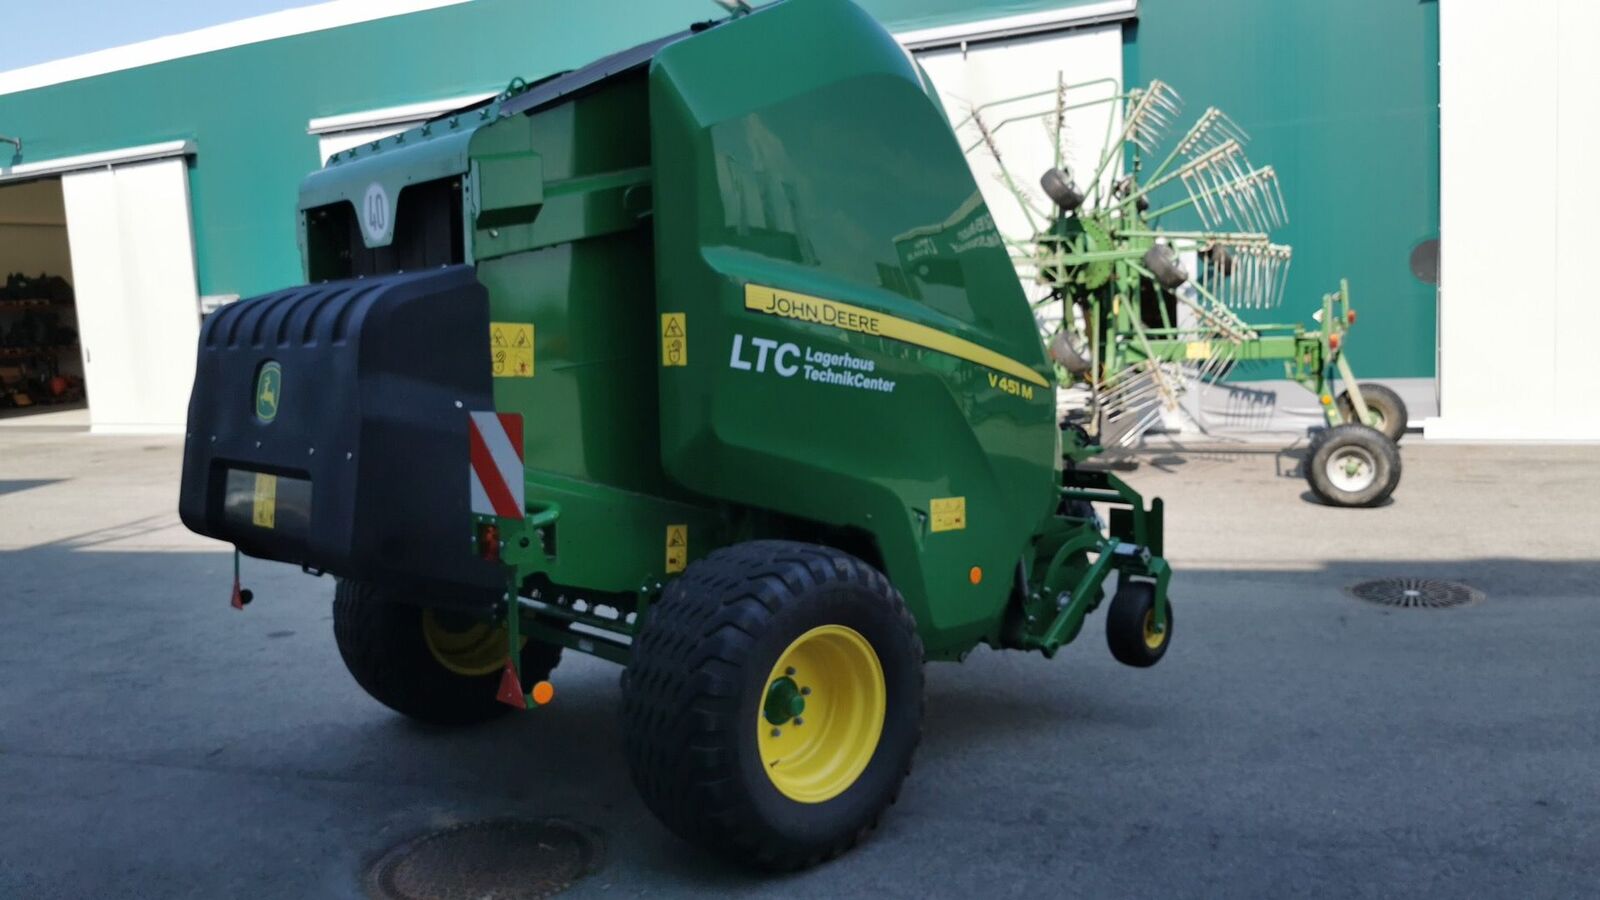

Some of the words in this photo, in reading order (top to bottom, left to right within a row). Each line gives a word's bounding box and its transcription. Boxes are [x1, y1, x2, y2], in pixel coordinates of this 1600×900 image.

[368, 193, 385, 231] 40
[766, 293, 818, 319] JOHN
[823, 304, 880, 332] DEERE
[730, 334, 801, 377] LTC
[805, 347, 875, 371] Lagerhaus
[804, 365, 896, 392] TechnikCenter
[988, 372, 998, 388] V
[998, 377, 1020, 396] 451
[1021, 384, 1033, 400] M
